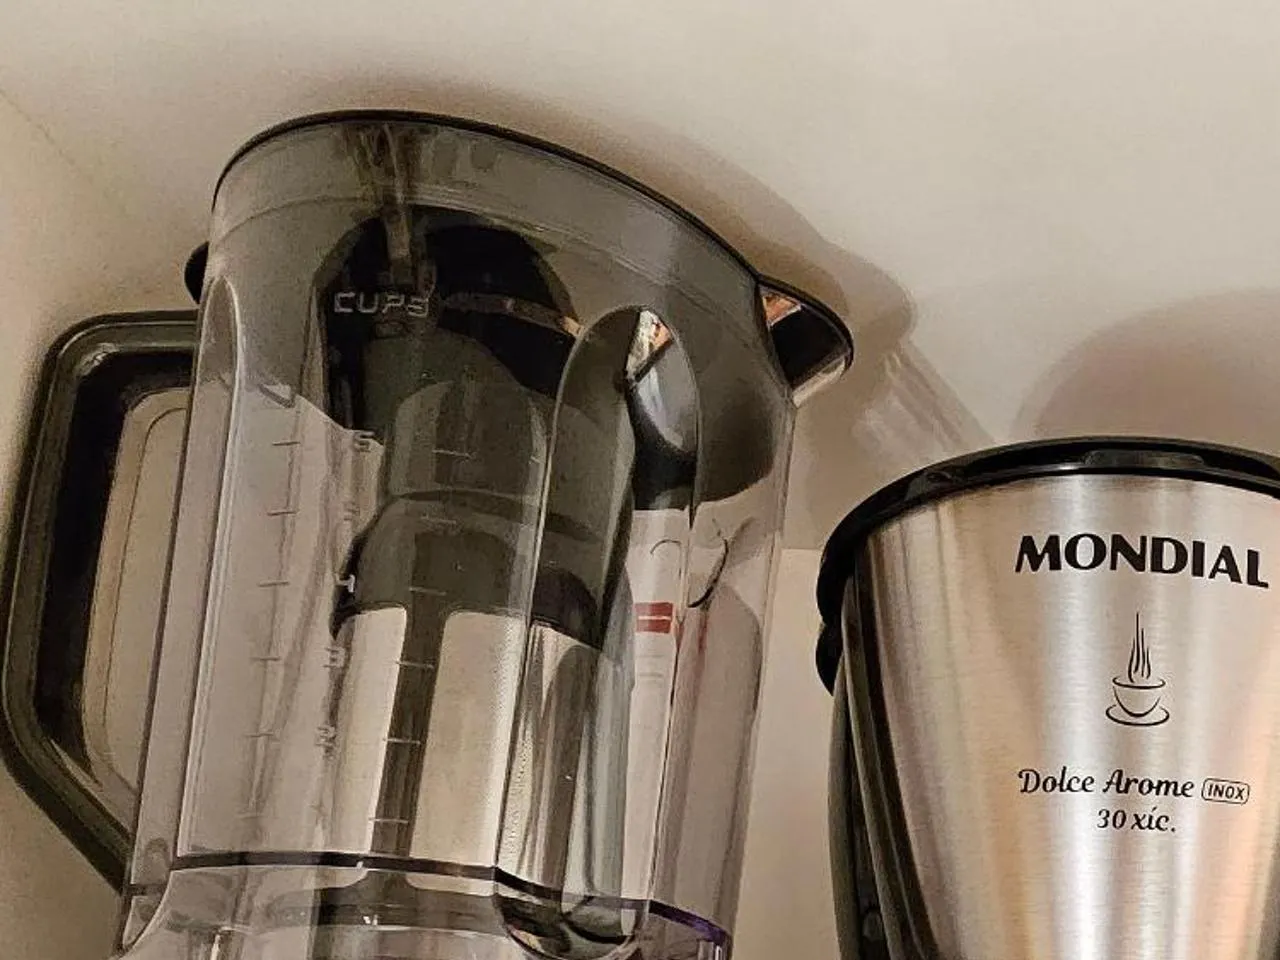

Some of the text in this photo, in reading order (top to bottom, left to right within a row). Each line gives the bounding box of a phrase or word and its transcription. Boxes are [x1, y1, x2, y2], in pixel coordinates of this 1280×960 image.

[334, 291, 429, 318] CUPS
[1015, 533, 1270, 589] MONDIAL
[1018, 766, 1246, 801] Dolce Arome INOX
[1097, 807, 1176, 833] 30 xíc.
